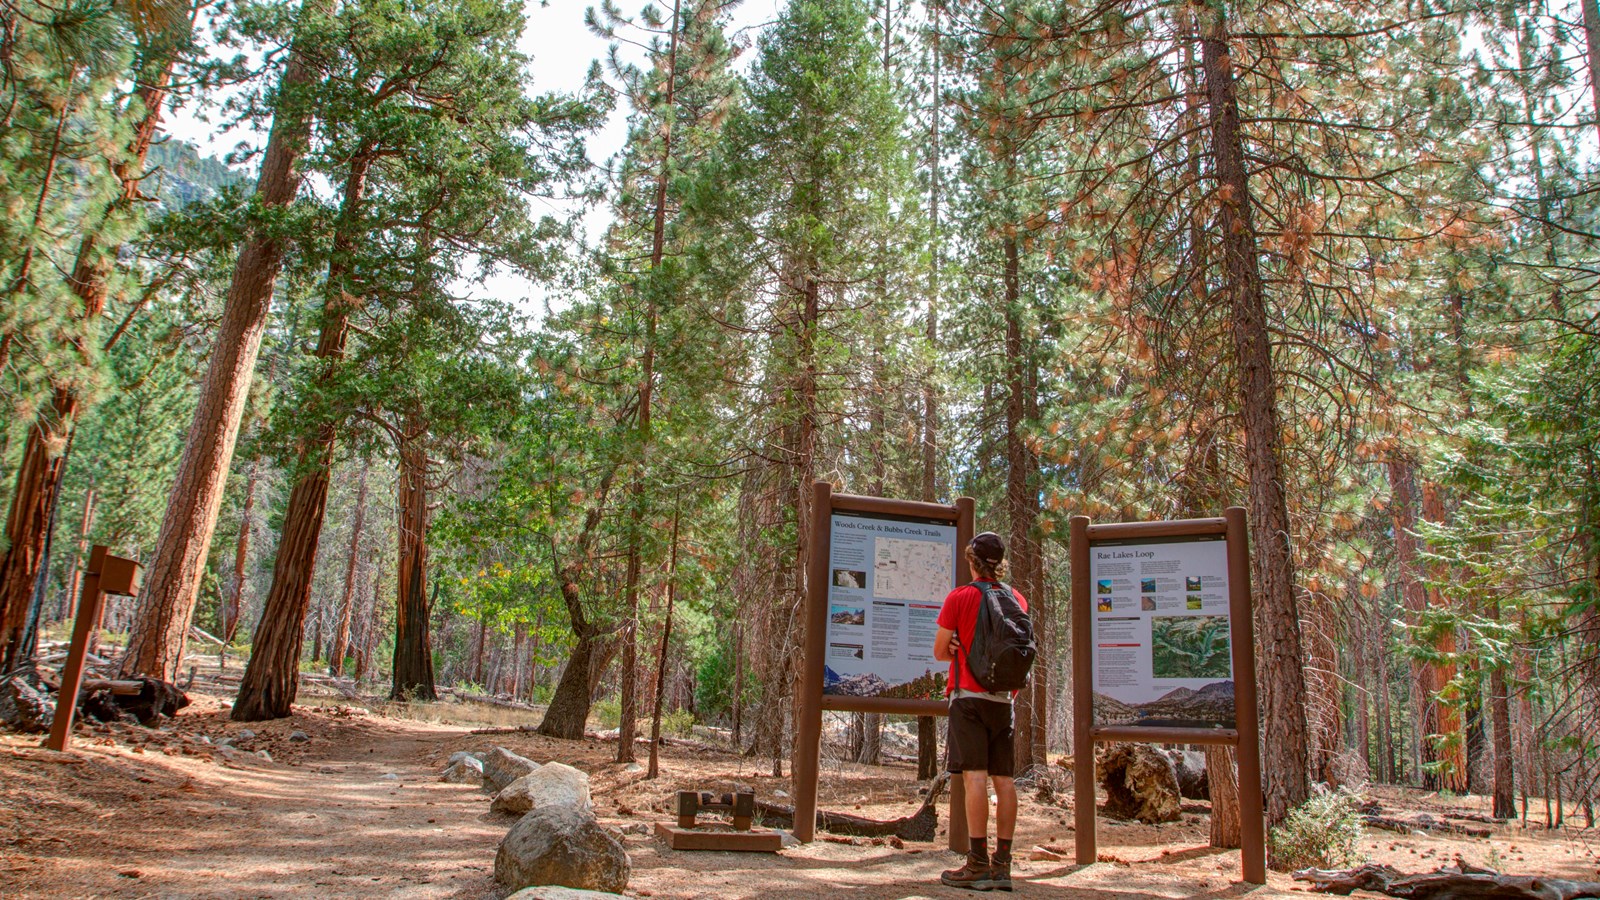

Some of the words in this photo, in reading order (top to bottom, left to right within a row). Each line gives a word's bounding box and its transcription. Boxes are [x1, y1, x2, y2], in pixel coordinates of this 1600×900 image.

[834, 520, 856, 529] Woods
[857, 523, 876, 531] Creek
[885, 526, 903, 534] Bubbs
[904, 527, 922, 536] Creek
[924, 529, 941, 537] Trails
[1112, 551, 1134, 559] Lakes
[1135, 550, 1155, 559] Loop
